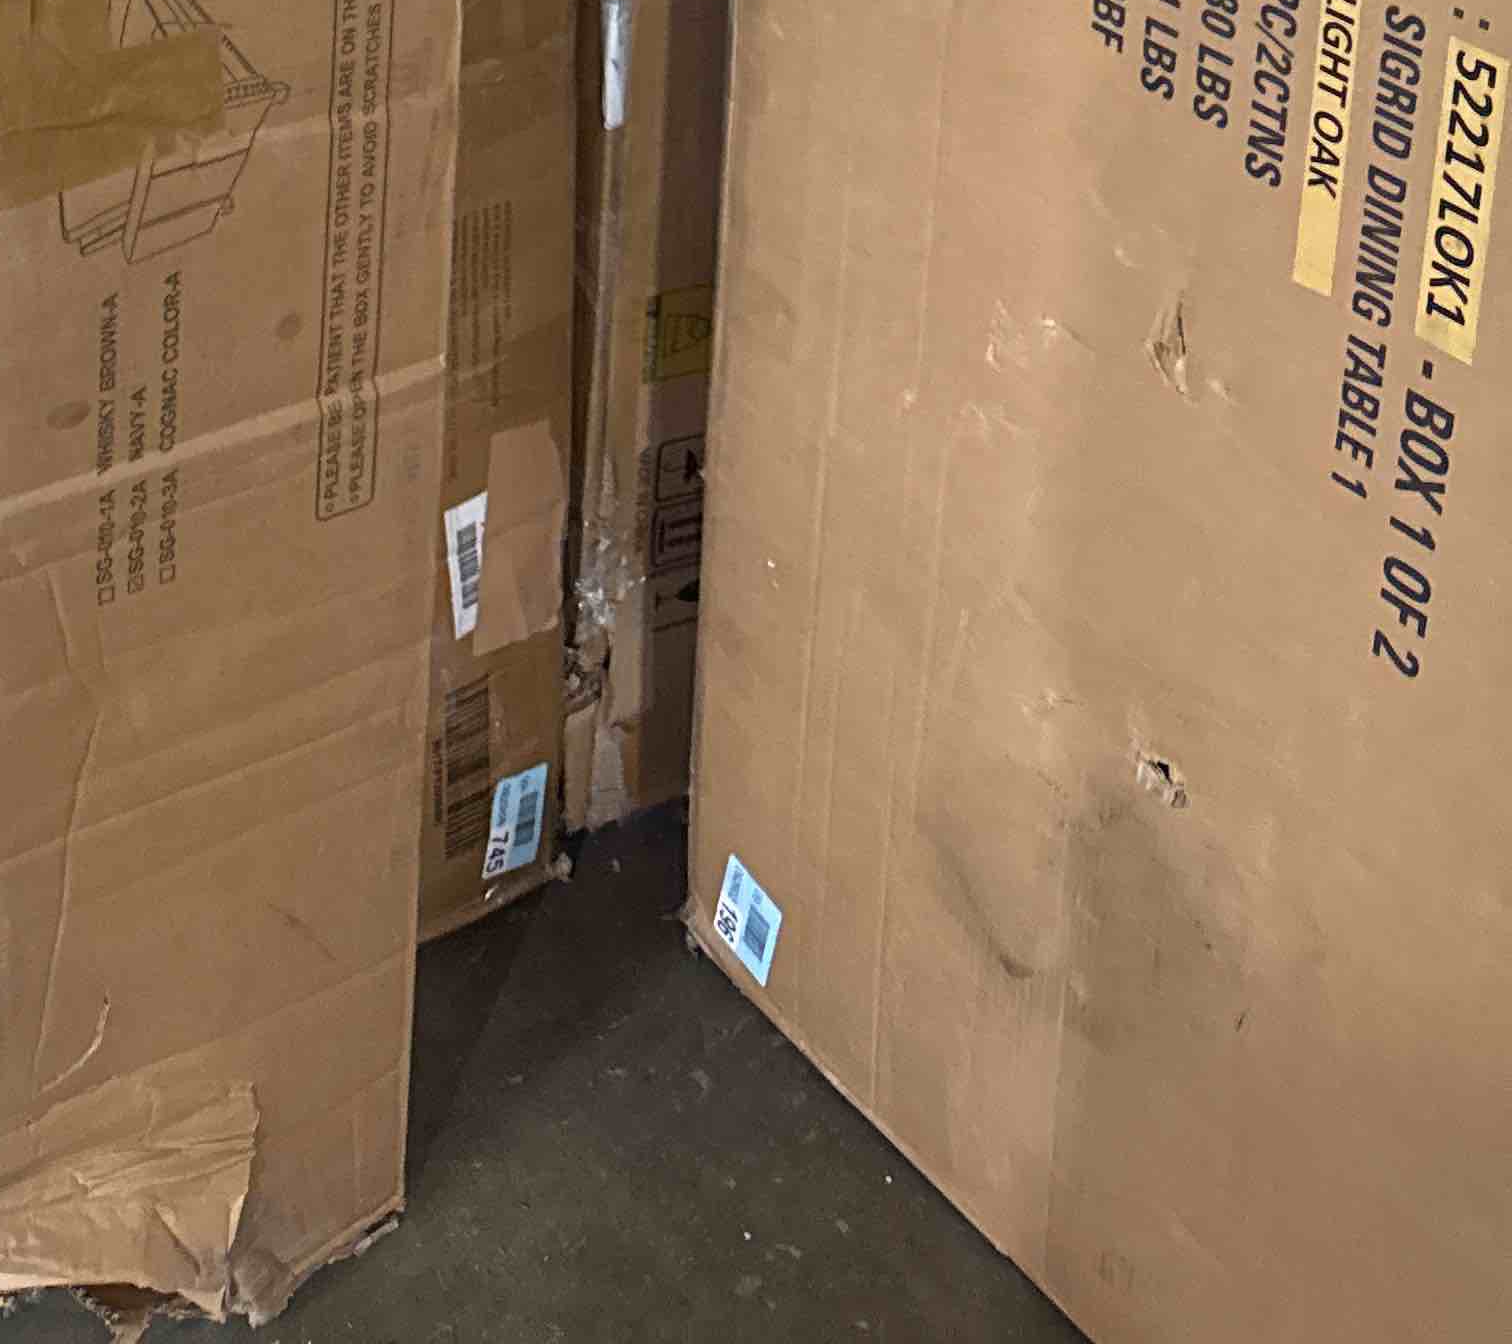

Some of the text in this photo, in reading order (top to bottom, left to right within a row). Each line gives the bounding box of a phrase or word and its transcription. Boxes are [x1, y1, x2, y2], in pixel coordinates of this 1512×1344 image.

[341, 28, 356, 56] ON
[362, 4, 381, 116] SCRATCHES
[1140, 16, 1179, 102] LBS
[339, 61, 354, 98] ARE
[1193, 43, 1234, 130] LBS
[1372, 5, 1426, 160] SIGRID
[361, 121, 377, 177] AVOID
[1307, 111, 1344, 200] OAK
[335, 165, 351, 228] OTHER
[360, 183, 375, 210] TO
[1425, 50, 1498, 327] 52217LOK1
[333, 231, 346, 265] THE
[356, 214, 373, 284] GENTLY
[1351, 164, 1407, 328] DINING
[329, 274, 345, 322] THAT
[353, 288, 368, 329] BOX
[325, 325, 343, 397] PATIENT
[352, 332, 368, 366] THE
[159, 368, 179, 453] COGNAC
[1335, 334, 1386, 470] TABLE
[1394, 388, 1455, 515] BOX
[1330, 471, 1367, 500] 1
[1389, 516, 1436, 551] 1
[1380, 556, 1432, 638] OF
[1371, 629, 1420, 678] 2
[487, 832, 509, 872] 745
